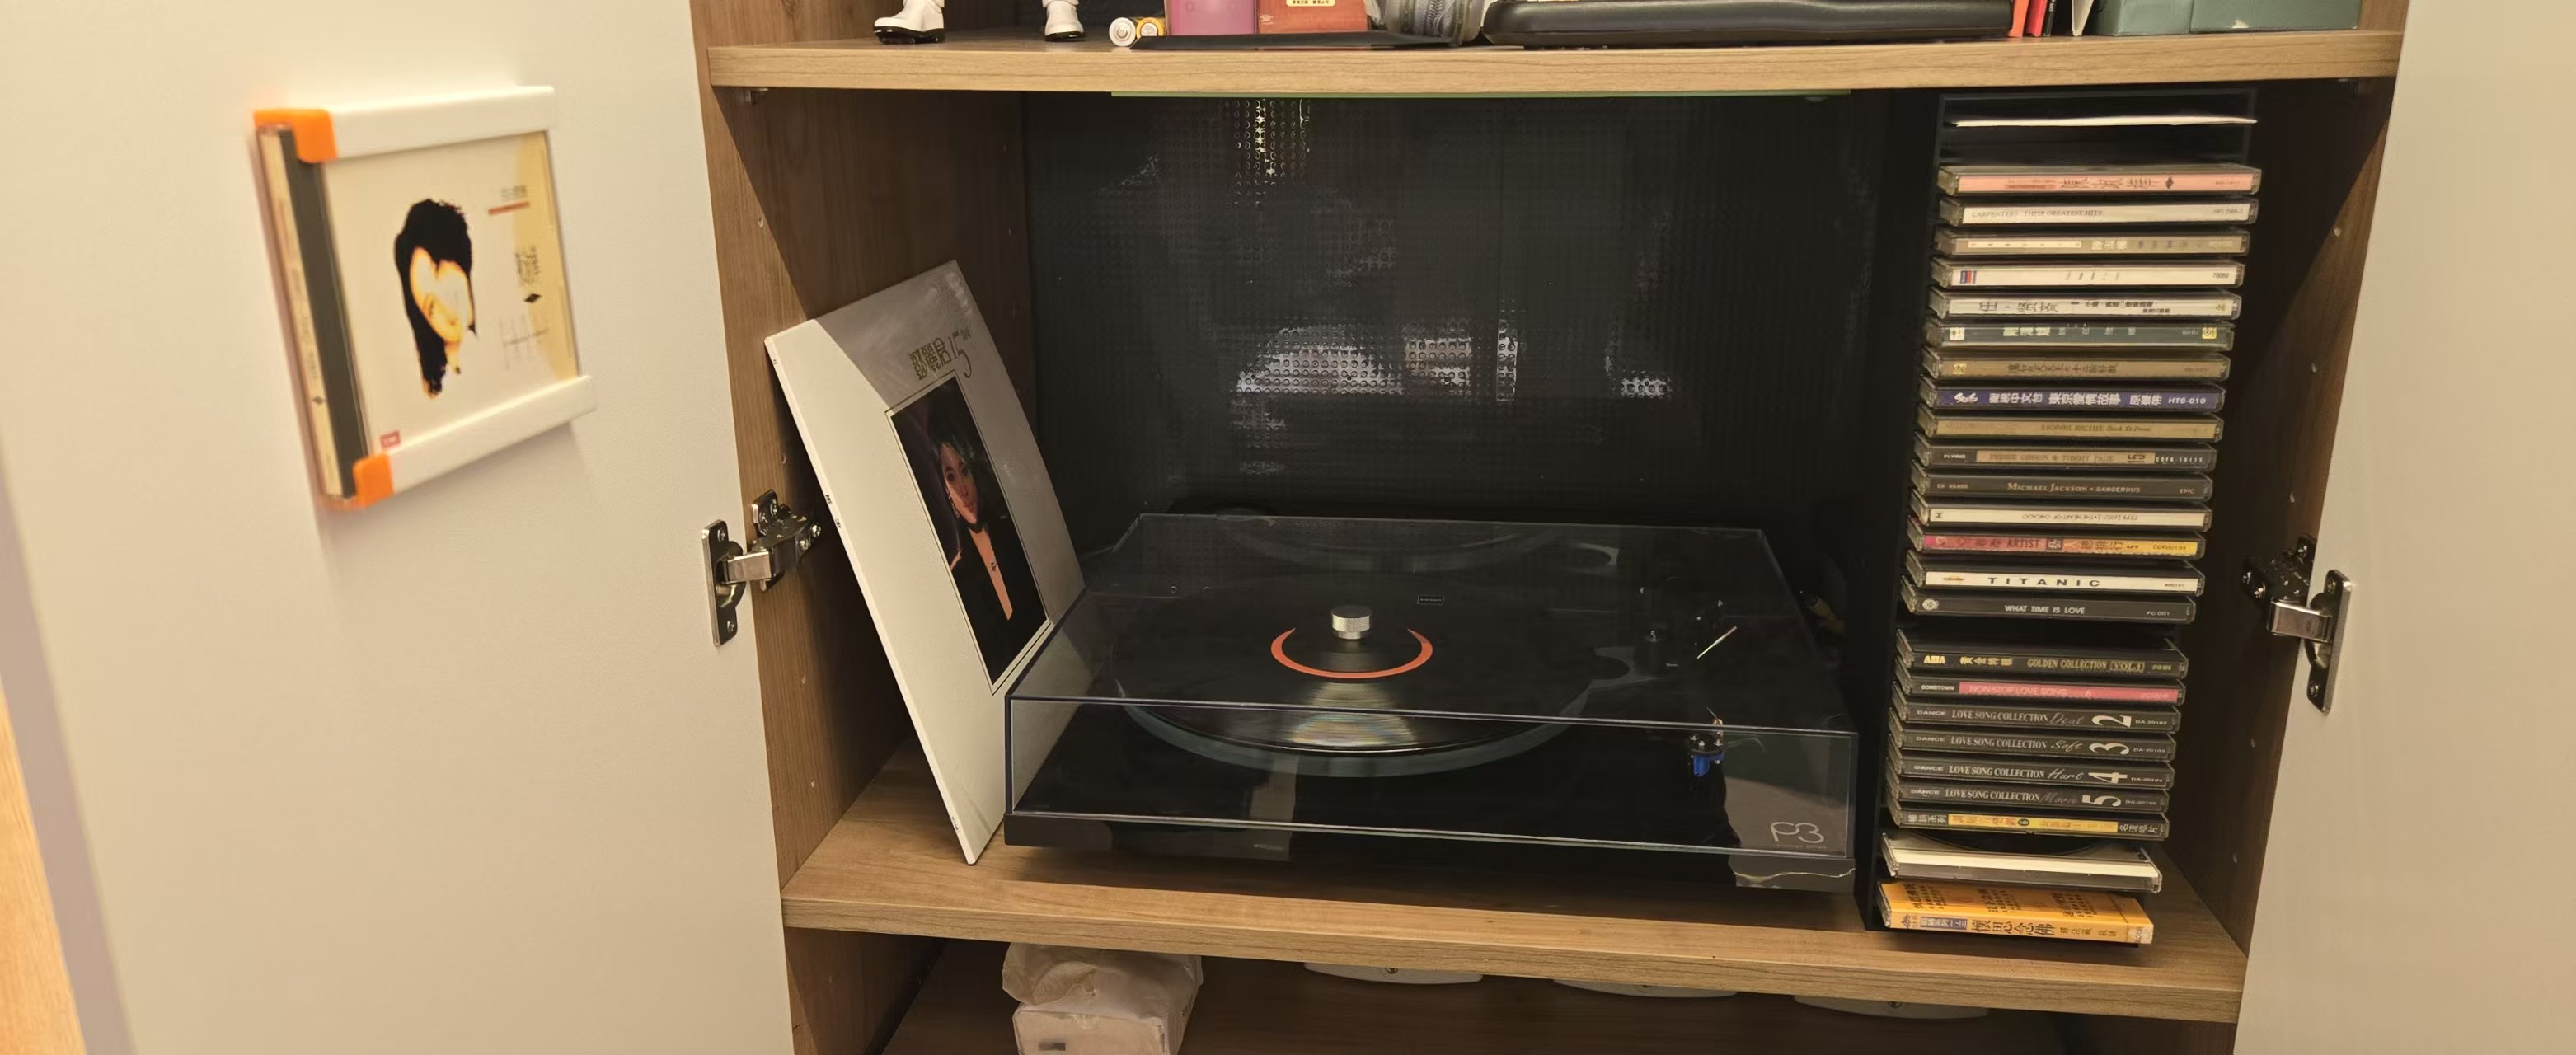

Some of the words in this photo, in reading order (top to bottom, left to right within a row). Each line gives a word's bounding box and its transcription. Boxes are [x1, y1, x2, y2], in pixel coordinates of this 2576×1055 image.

[2167, 396, 2207, 405] HTS-010
[2006, 538, 2040, 549] ARTIST
[1987, 576, 2100, 588] TITANIC
[2004, 604, 2028, 613] WHAT
[2030, 605, 2050, 614] TIME
[2053, 605, 2061, 614] IS
[2063, 606, 2086, 615] LOVE
[2026, 658, 2058, 668] GOLDEN
[2060, 659, 2108, 670] COLLECTION
[2015, 687, 2041, 696] LOVE
[2042, 687, 2069, 696] SONG
[1951, 710, 1974, 720] LOVE
[1974, 710, 1997, 721] SONG
[1997, 711, 2048, 723] COLLECTION
[1950, 735, 1973, 746] LOVE
[1973, 737, 1996, 748] SONG
[1996, 738, 2047, 749] COLLECTION
[1948, 764, 1971, 775] LOVE
[1970, 766, 1993, 776] SONG
[1993, 767, 2046, 779] COLLECTION
[1945, 789, 1968, 799] LOVE
[1967, 790, 1990, 800] SONG
[1989, 790, 2041, 802] COLLECTION
[1770, 821, 1825, 844] P3
